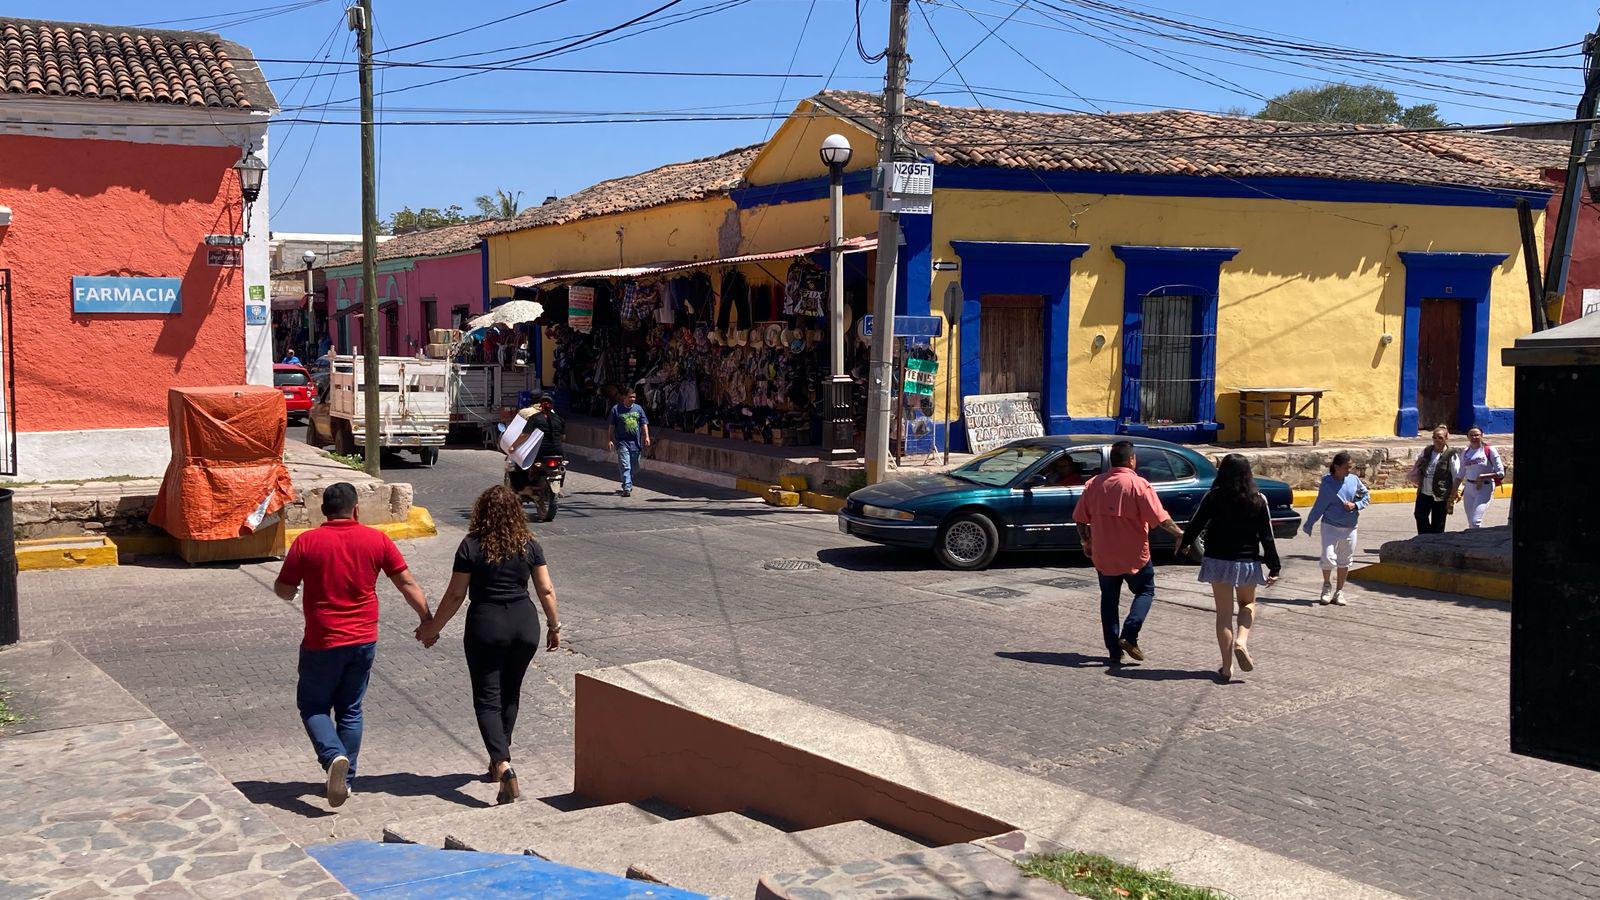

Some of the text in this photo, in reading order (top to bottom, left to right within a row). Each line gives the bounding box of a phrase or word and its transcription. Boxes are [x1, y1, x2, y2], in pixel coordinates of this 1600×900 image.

[75, 287, 177, 302] FARMACIA
[905, 369, 932, 383] TENIS
[975, 425, 1039, 442] ZAPATERIA
